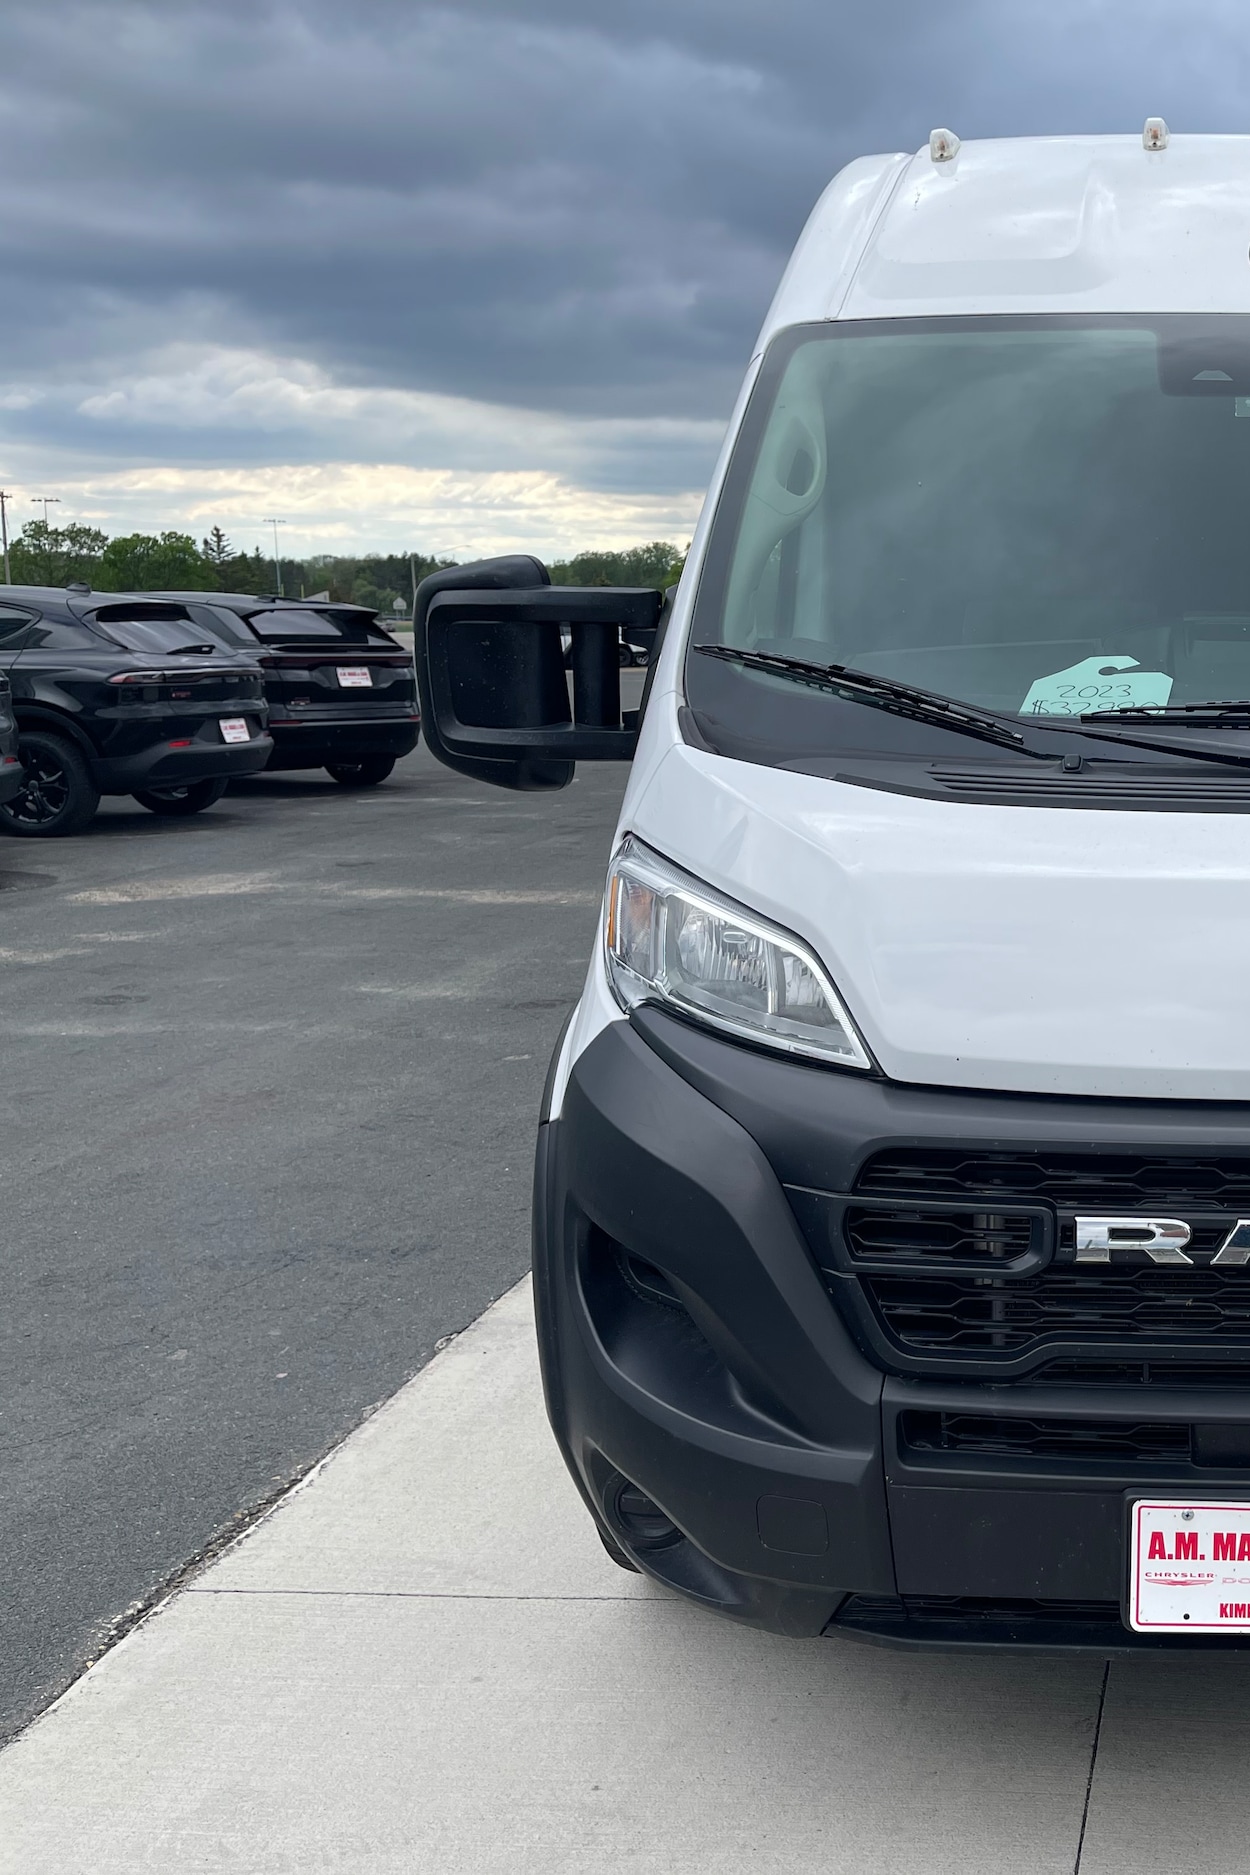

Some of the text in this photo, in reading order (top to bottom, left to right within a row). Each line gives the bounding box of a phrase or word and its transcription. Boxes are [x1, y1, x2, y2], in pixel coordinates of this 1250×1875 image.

[1056, 684, 1132, 699] 2023
[1148, 1531, 1206, 1560] A.M.
[1144, 1571, 1215, 1579] CHRYSLER
